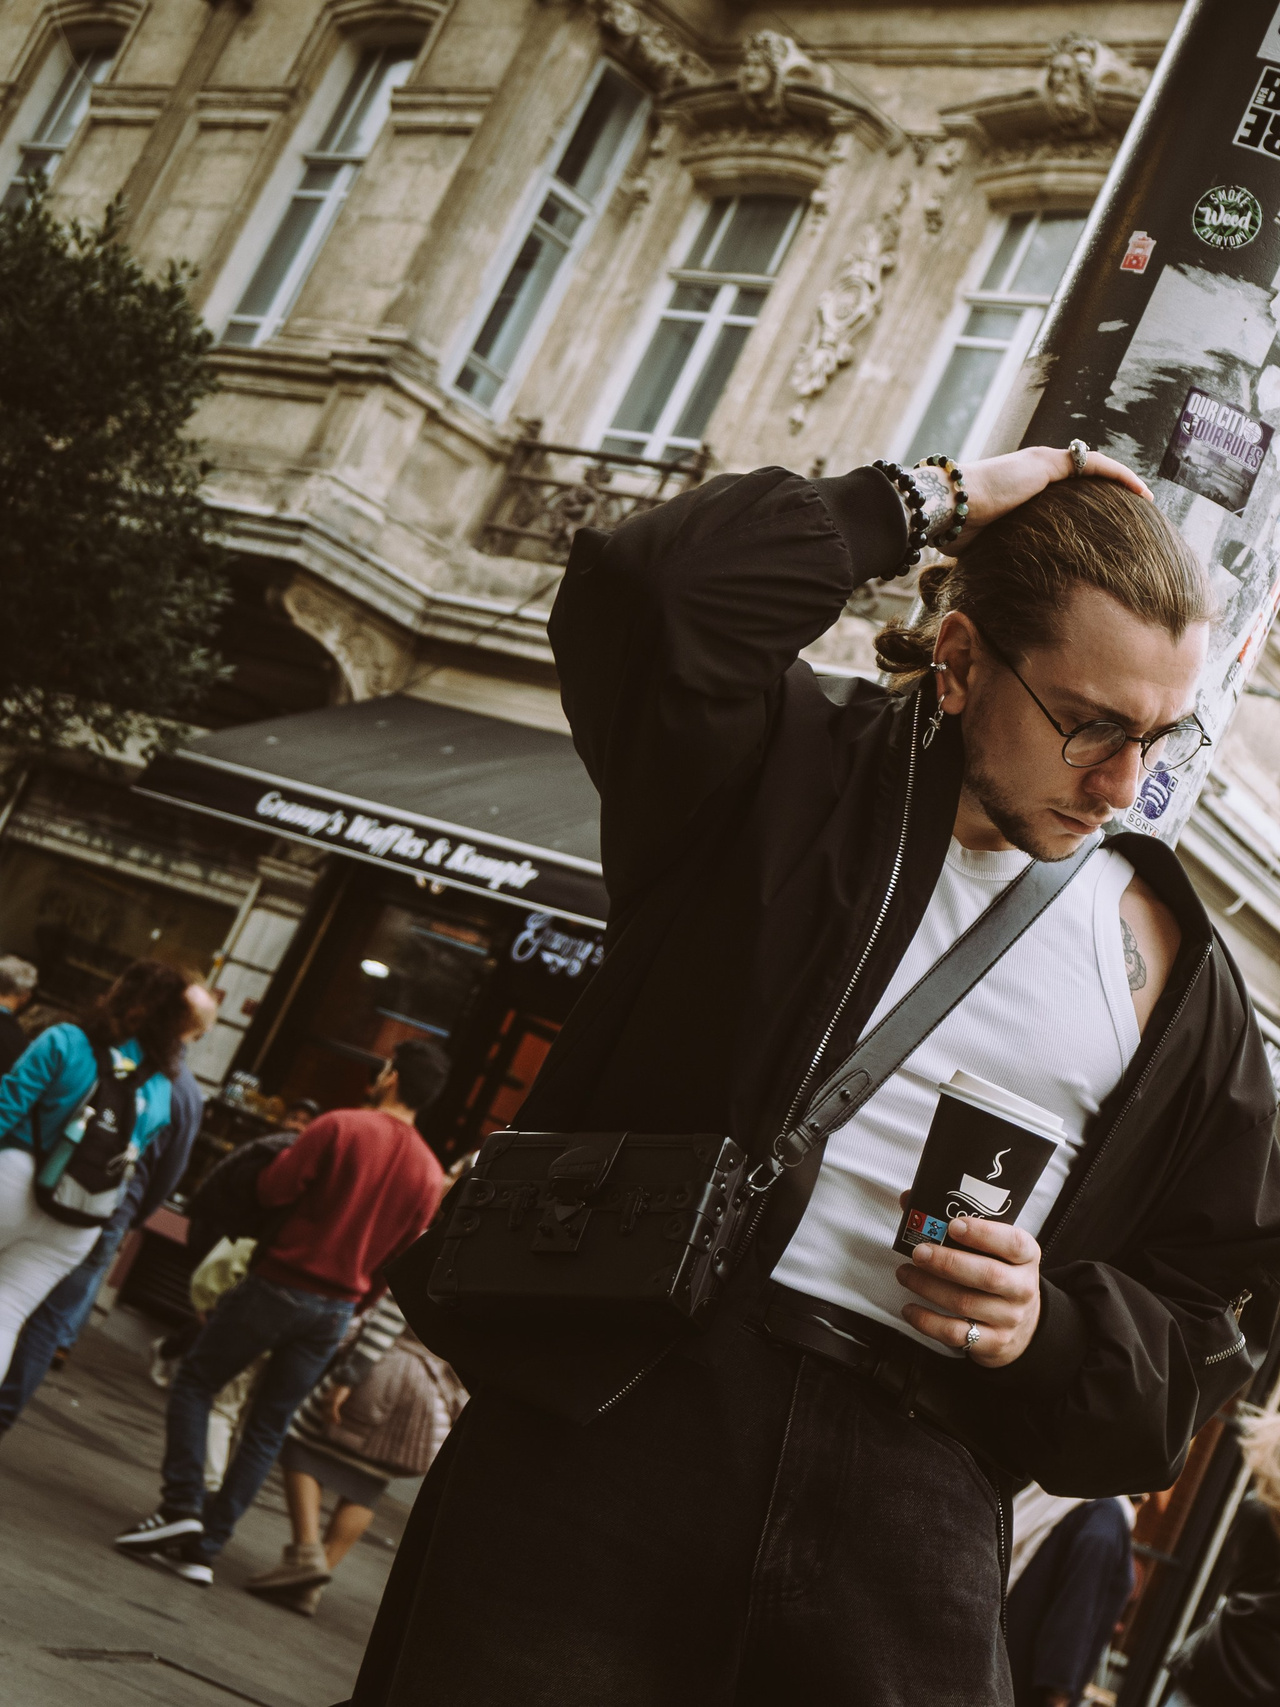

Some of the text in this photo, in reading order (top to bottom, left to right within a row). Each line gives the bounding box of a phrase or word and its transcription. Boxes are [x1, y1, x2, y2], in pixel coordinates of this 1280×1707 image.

[1210, 189, 1251, 208] SMOKE
[1198, 204, 1252, 232] Weed
[1200, 227, 1247, 246] EVERYDAY
[1187, 392, 1220, 424] OUR
[1217, 405, 1251, 437] CITY
[1194, 419, 1224, 447] OUR
[1222, 432, 1262, 468] RULES
[344, 814, 429, 860] Waffles
[423, 837, 451, 866] &
[443, 843, 540, 891] Kumpir
